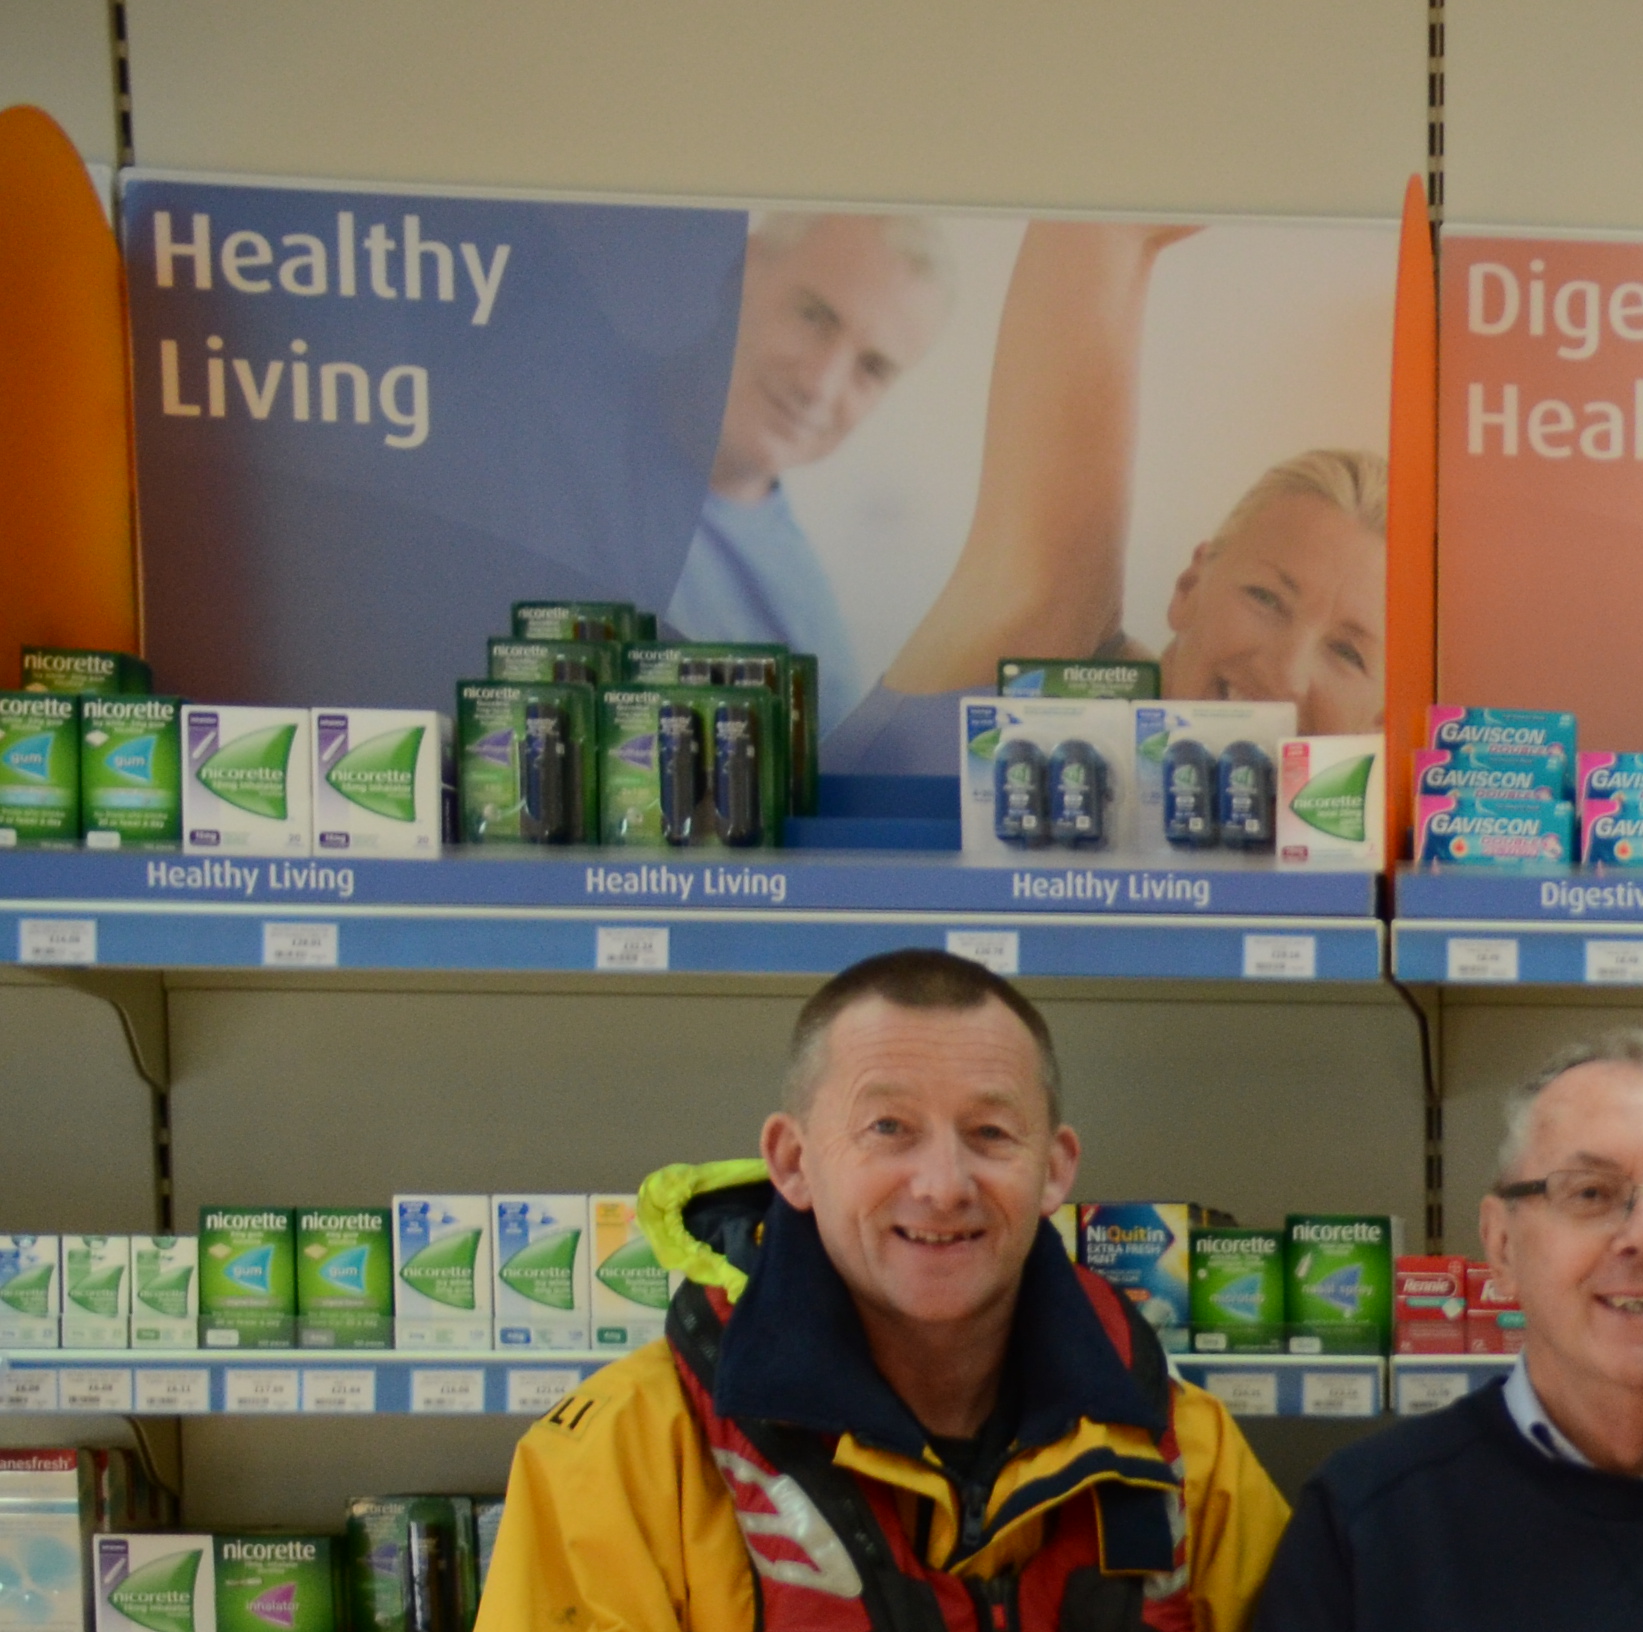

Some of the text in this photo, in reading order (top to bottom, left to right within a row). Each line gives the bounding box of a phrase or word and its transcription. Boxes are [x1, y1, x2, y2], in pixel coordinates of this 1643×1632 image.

[153, 211, 511, 325] Healthy
[160, 335, 430, 449] Living
[492, 644, 548, 658] nicorette
[24, 653, 114, 675] nicorette
[1063, 666, 1138, 683] nicorette
[463, 687, 520, 700] nicorette
[604, 690, 660, 703] nicorette
[83, 699, 174, 721] nicorette
[1441, 722, 1544, 746] GAVISCON
[10, 751, 42, 766] gum
[114, 754, 146, 768] gum
[202, 767, 283, 781] nicorette
[331, 768, 412, 783] nicorette
[1426, 767, 1532, 789] GAVISCON
[1430, 815, 1539, 836] GAVISCON
[147, 862, 355, 897] Healthy Living
[586, 866, 787, 902] Healthy Living
[1012, 872, 1210, 906] Healthy Living
[206, 1213, 288, 1232] nicorette
[301, 1213, 383, 1231] nicorette
[1087, 1225, 1165, 1243] NiQuitin
[1293, 1222, 1382, 1243] nicorette
[1196, 1236, 1276, 1253] nicorette
[233, 1265, 262, 1278] gum
[328, 1265, 358, 1278] gum
[402, 1265, 472, 1278] nicorette
[501, 1265, 571, 1278] nicorette
[1403, 1279, 1449, 1293] Rennie
[0, 1455, 73, 1472] anesfresh
[223, 1541, 316, 1561] nicorette
[113, 1590, 191, 1604] nicorette
[246, 1600, 300, 1613] inhalator
